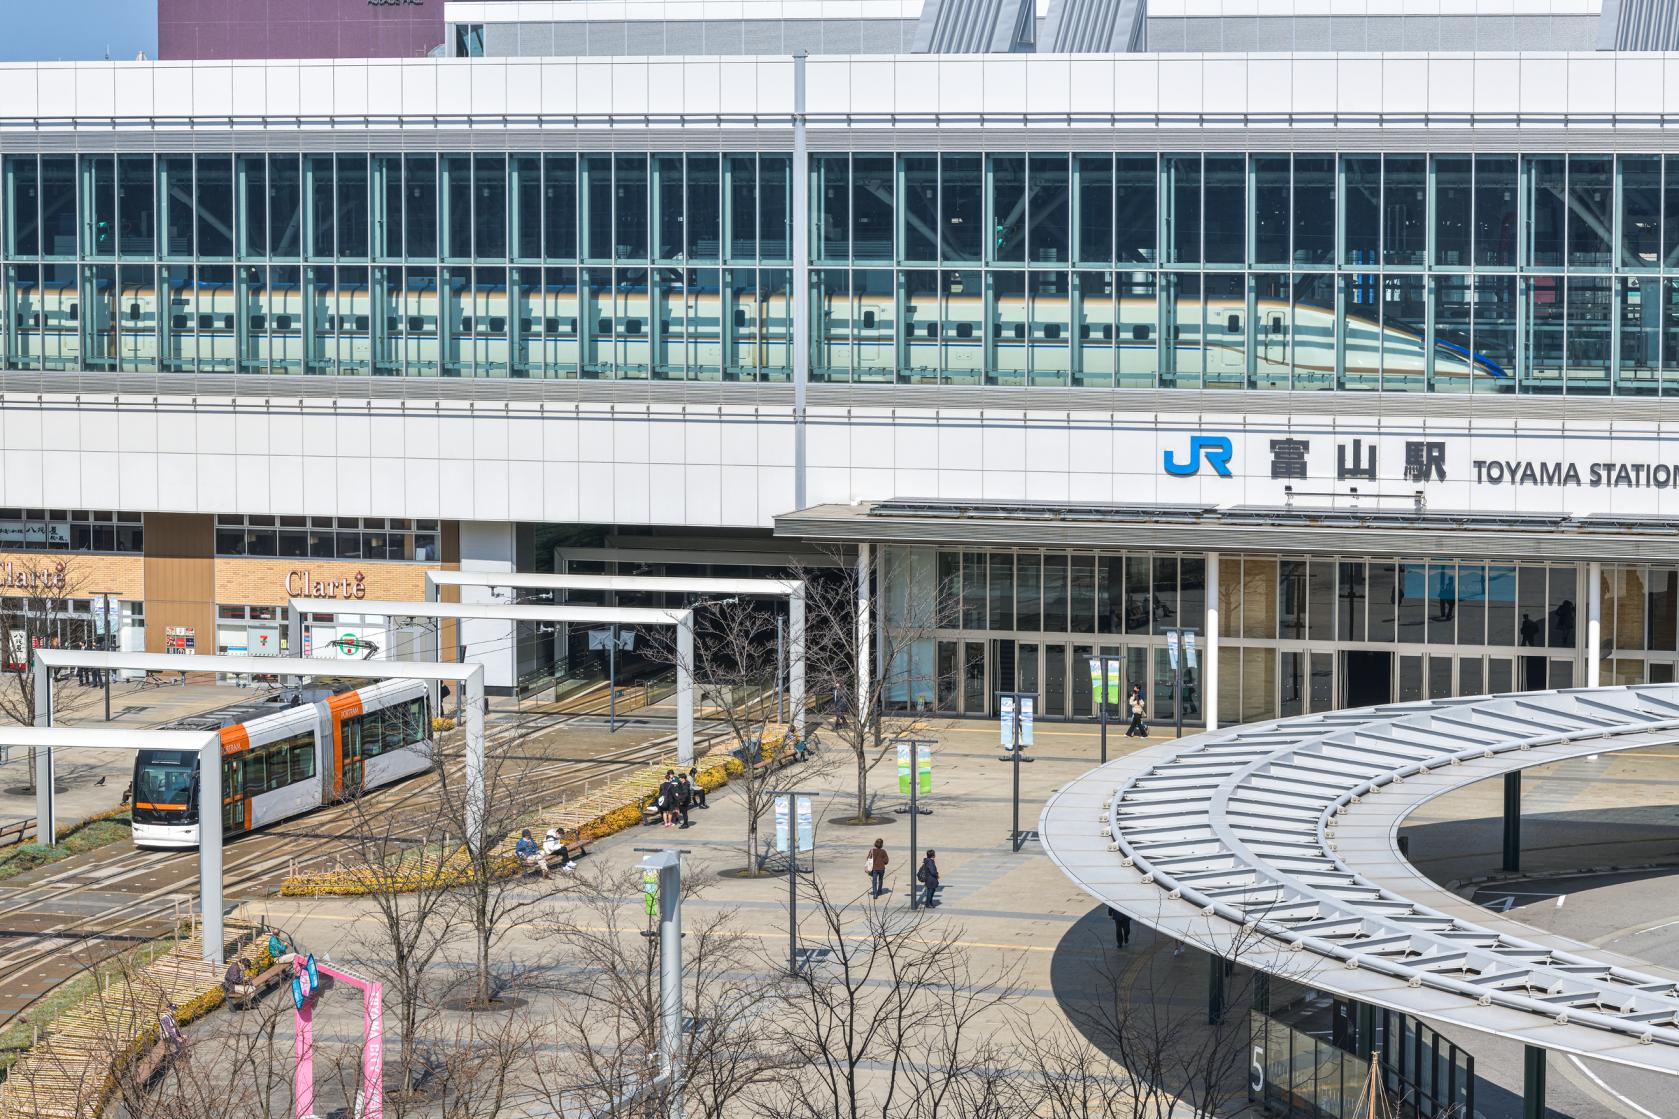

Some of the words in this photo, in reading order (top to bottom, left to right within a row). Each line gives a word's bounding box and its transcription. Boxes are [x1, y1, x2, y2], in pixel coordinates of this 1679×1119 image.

[1164, 435, 1233, 478] JR
[1269, 438, 1447, 483] 富山駅
[1473, 460, 1582, 487] TOYAMA
[1251, 1045, 1264, 1092] 5
